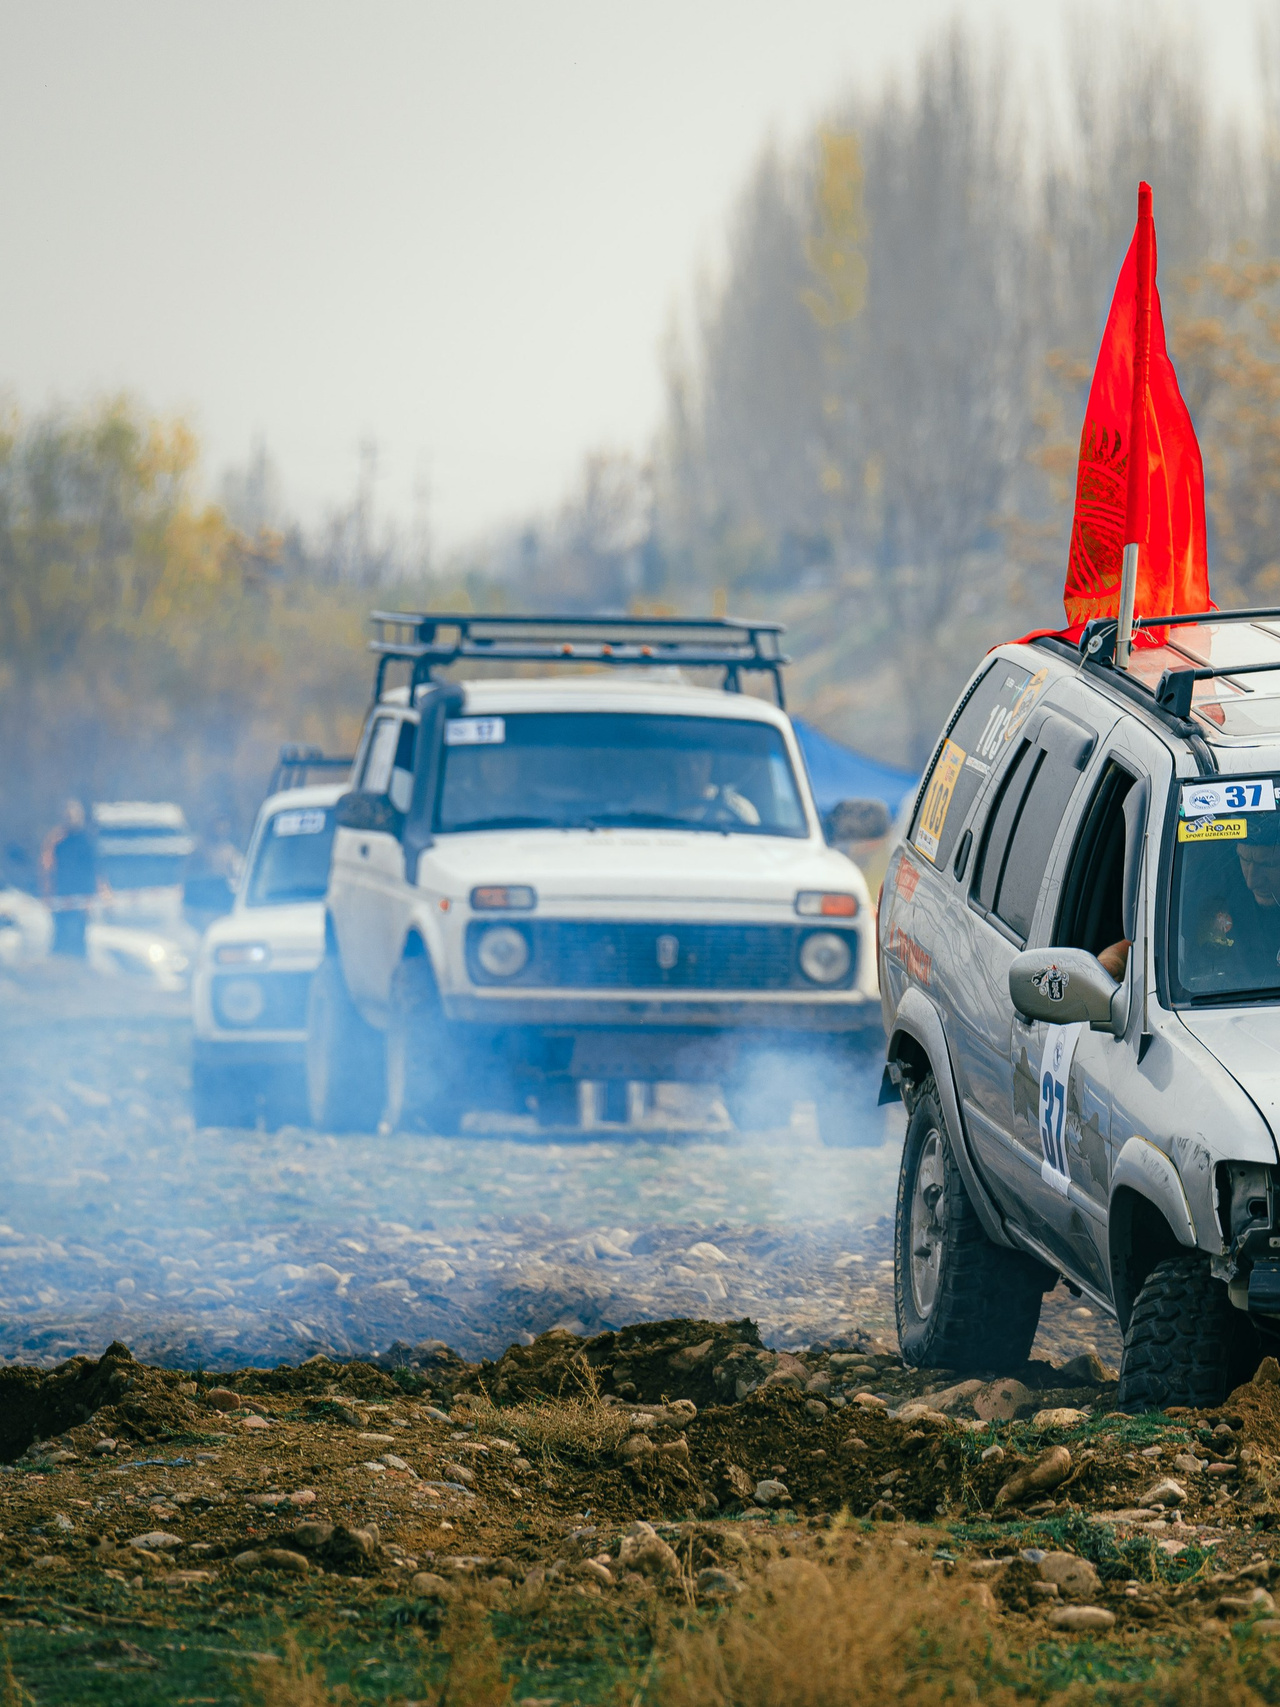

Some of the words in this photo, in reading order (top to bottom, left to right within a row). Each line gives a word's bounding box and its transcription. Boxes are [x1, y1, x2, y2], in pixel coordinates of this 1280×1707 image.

[976, 704, 1013, 760] 103
[924, 780, 949, 834] 103
[1225, 784, 1263, 808] 37
[1185, 813, 1217, 833] OFF
[1206, 823, 1241, 833] ROAD
[1042, 1071, 1066, 1177] 37
